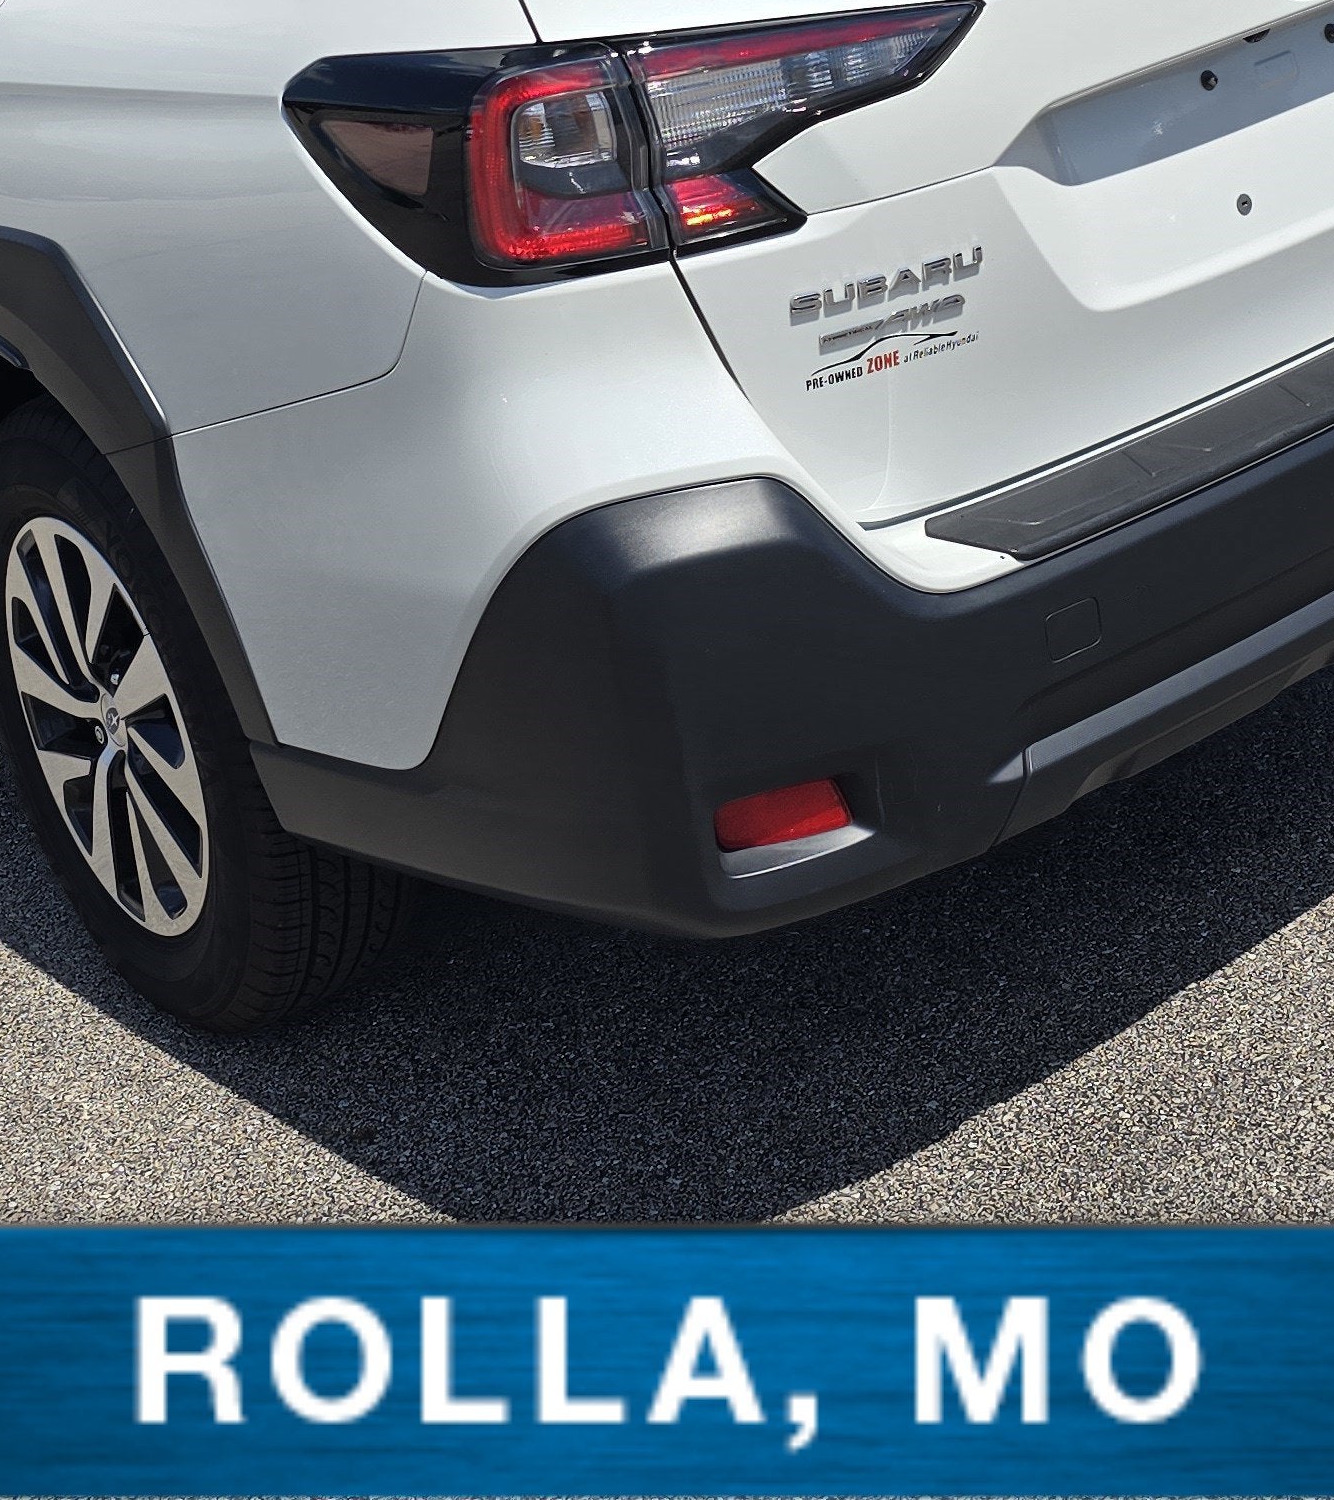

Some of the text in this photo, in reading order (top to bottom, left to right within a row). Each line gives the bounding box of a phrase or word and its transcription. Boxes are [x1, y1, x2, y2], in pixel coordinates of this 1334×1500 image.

[790, 246, 983, 318] SUBARU
[805, 365, 864, 392] PRE-OWNED
[866, 349, 901, 375] ZONE
